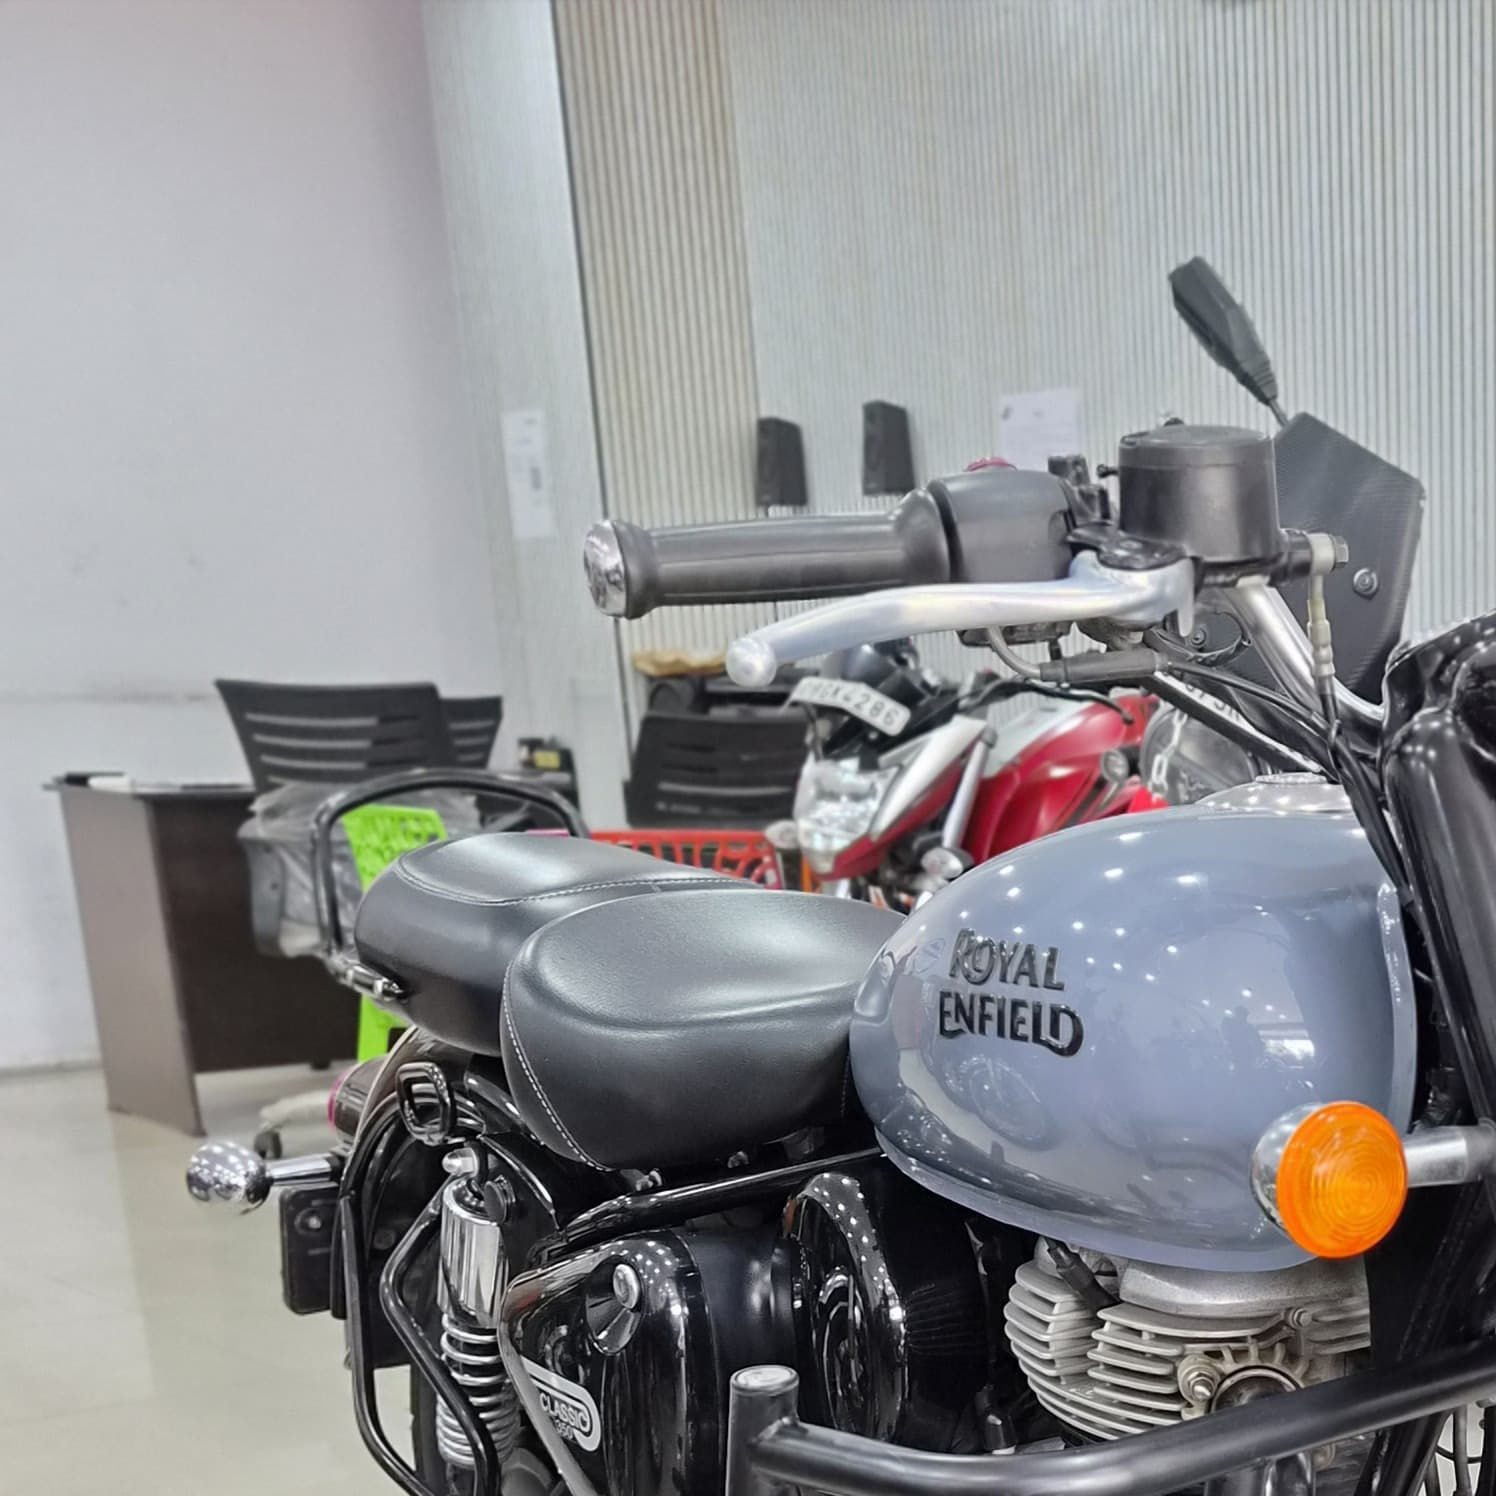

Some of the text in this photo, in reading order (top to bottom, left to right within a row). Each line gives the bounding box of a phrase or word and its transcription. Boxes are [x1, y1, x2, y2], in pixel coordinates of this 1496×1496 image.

[949, 927, 1065, 991] ROYAL
[939, 990, 1084, 1057] ENFIELD
[540, 1392, 590, 1432] CLASSIC
